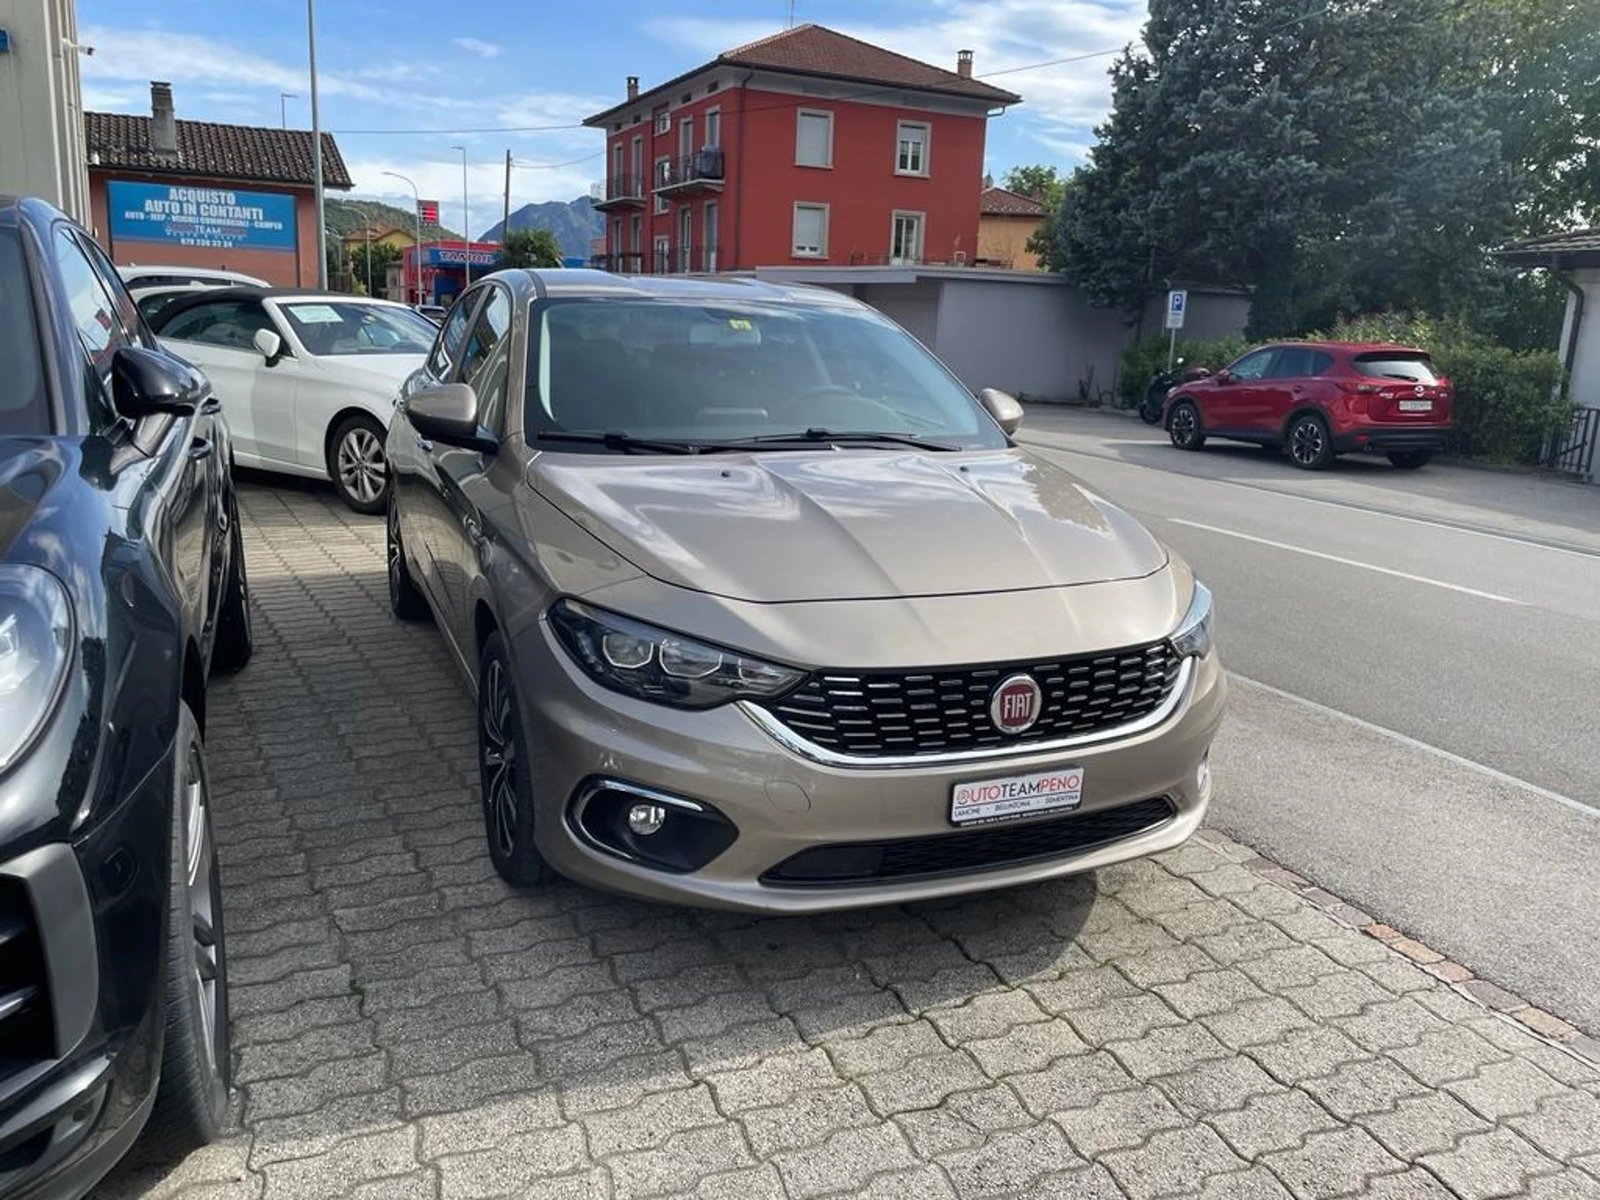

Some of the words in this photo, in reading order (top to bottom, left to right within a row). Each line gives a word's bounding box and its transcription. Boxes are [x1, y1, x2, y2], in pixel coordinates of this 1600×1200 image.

[169, 187, 236, 206] ACQUISTO
[144, 199, 180, 215] AUTO
[182, 202, 198, 216] IN
[200, 204, 264, 221] CONTANTI
[1004, 692, 1034, 720] FIAT
